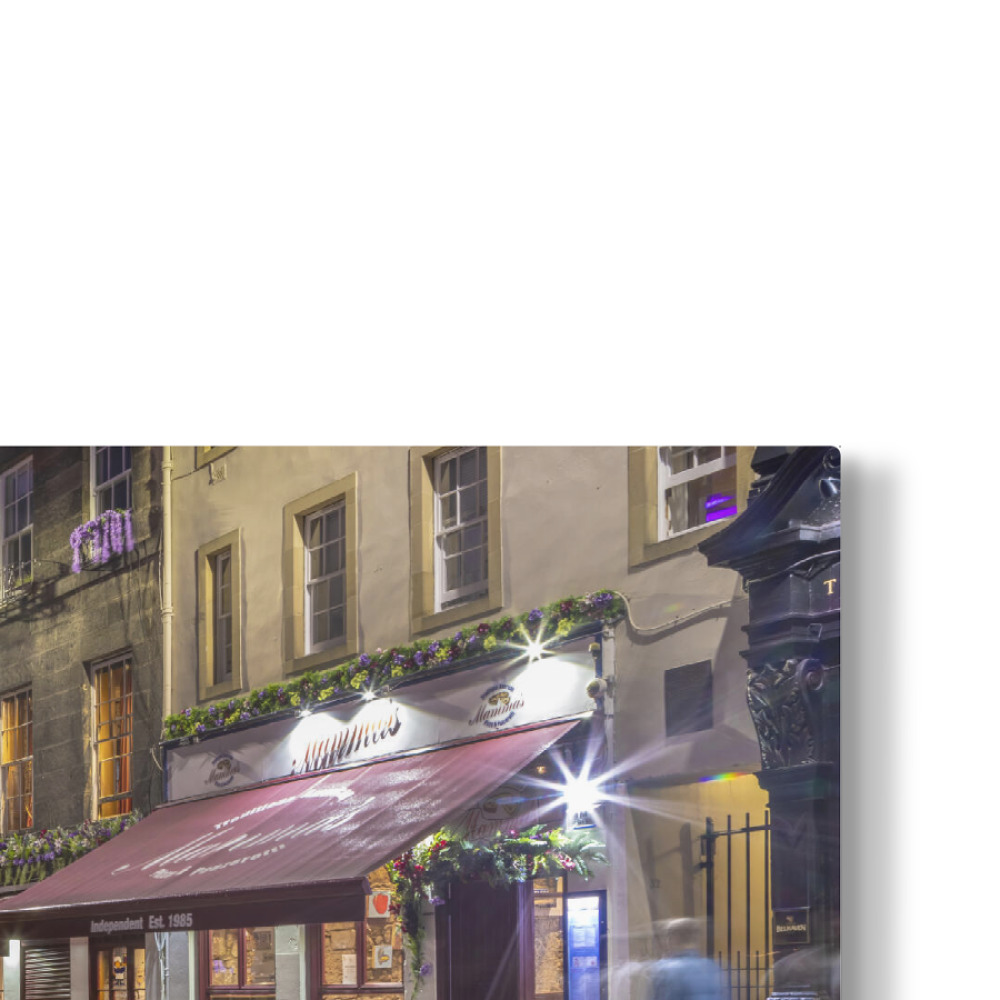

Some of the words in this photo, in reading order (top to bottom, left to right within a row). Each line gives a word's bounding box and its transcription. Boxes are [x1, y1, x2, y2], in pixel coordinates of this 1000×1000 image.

[90, 917, 144, 934] Independent
[148, 915, 165, 929] Est.
[168, 912, 193, 928] 1985
